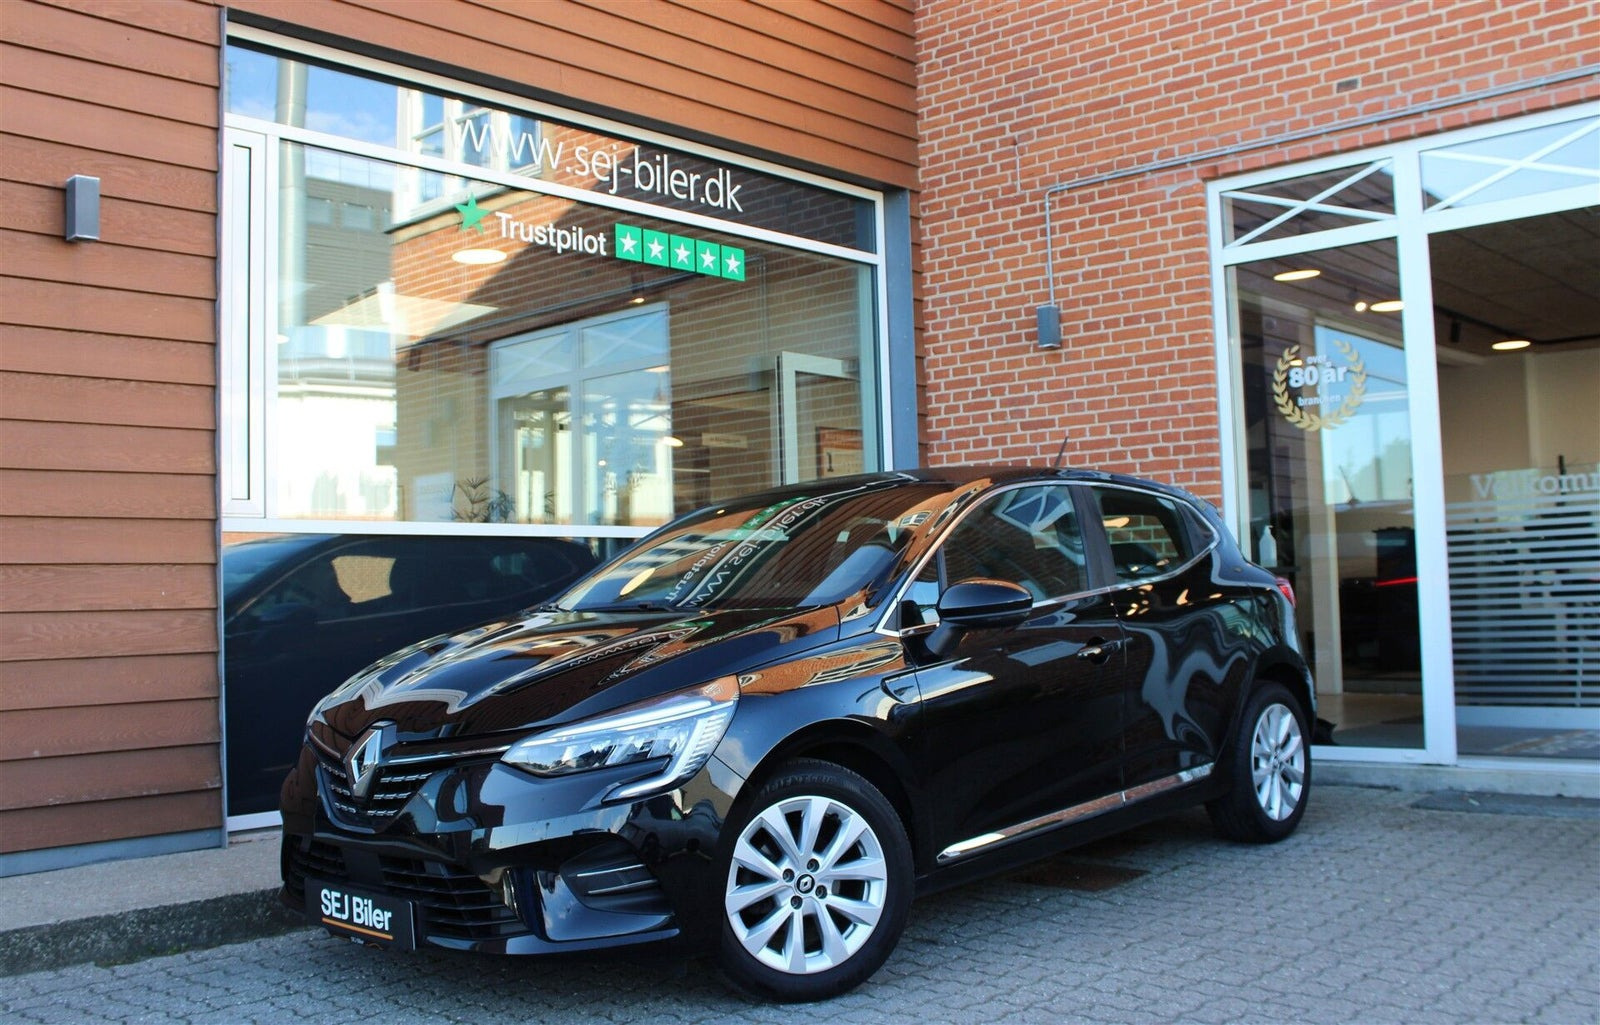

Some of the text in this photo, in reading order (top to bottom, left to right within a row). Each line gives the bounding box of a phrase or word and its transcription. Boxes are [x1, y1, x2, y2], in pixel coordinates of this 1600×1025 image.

[452, 118, 744, 212] www.sej-biler.dk
[495, 211, 607, 256] Trustpilot
[1289, 365, 1319, 388] 80
[320, 888, 392, 931] SEJ Biler
